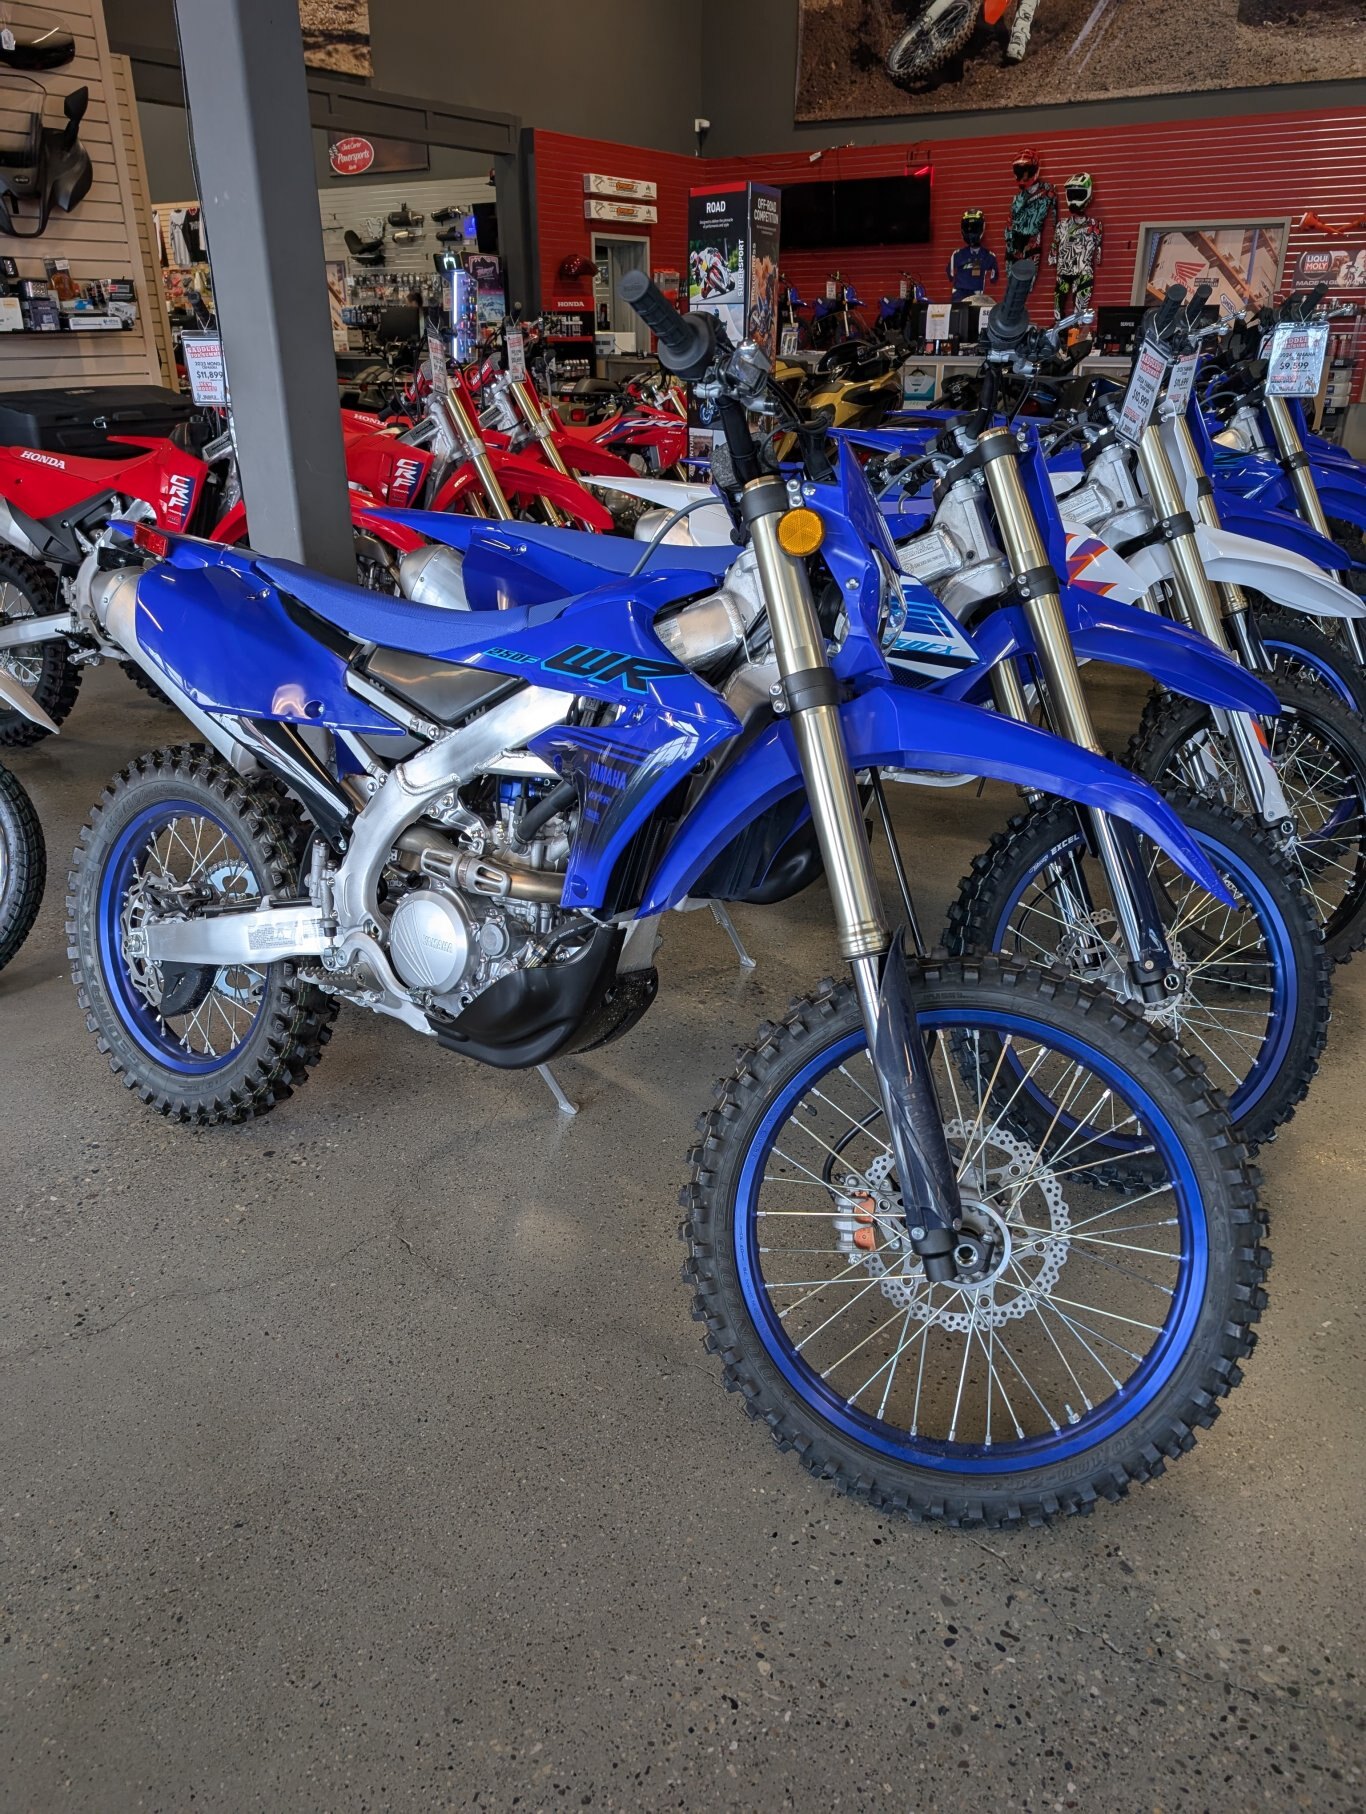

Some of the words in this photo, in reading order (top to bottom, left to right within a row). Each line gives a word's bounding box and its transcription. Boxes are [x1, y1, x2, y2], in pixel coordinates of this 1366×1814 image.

[337, 150, 370, 165] Powersports
[706, 201, 726, 214] ROAD
[757, 198, 777, 212] OFF-ROAD
[753, 209, 779, 225] COMPETITION
[1305, 262, 1327, 270] MOLY
[1307, 255, 1329, 263] LIQUI
[196, 370, 224, 380] $11,899
[20, 450, 66, 470] HONDA
[391, 457, 420, 488] CRF
[167, 474, 191, 508] CRF
[483, 647, 542, 664] 250F
[540, 643, 692, 695] WR
[589, 760, 628, 791] YAMAHA
[1050, 833, 1080, 856] EXCEL
[716, 1238, 782, 1387] DUNLOP
